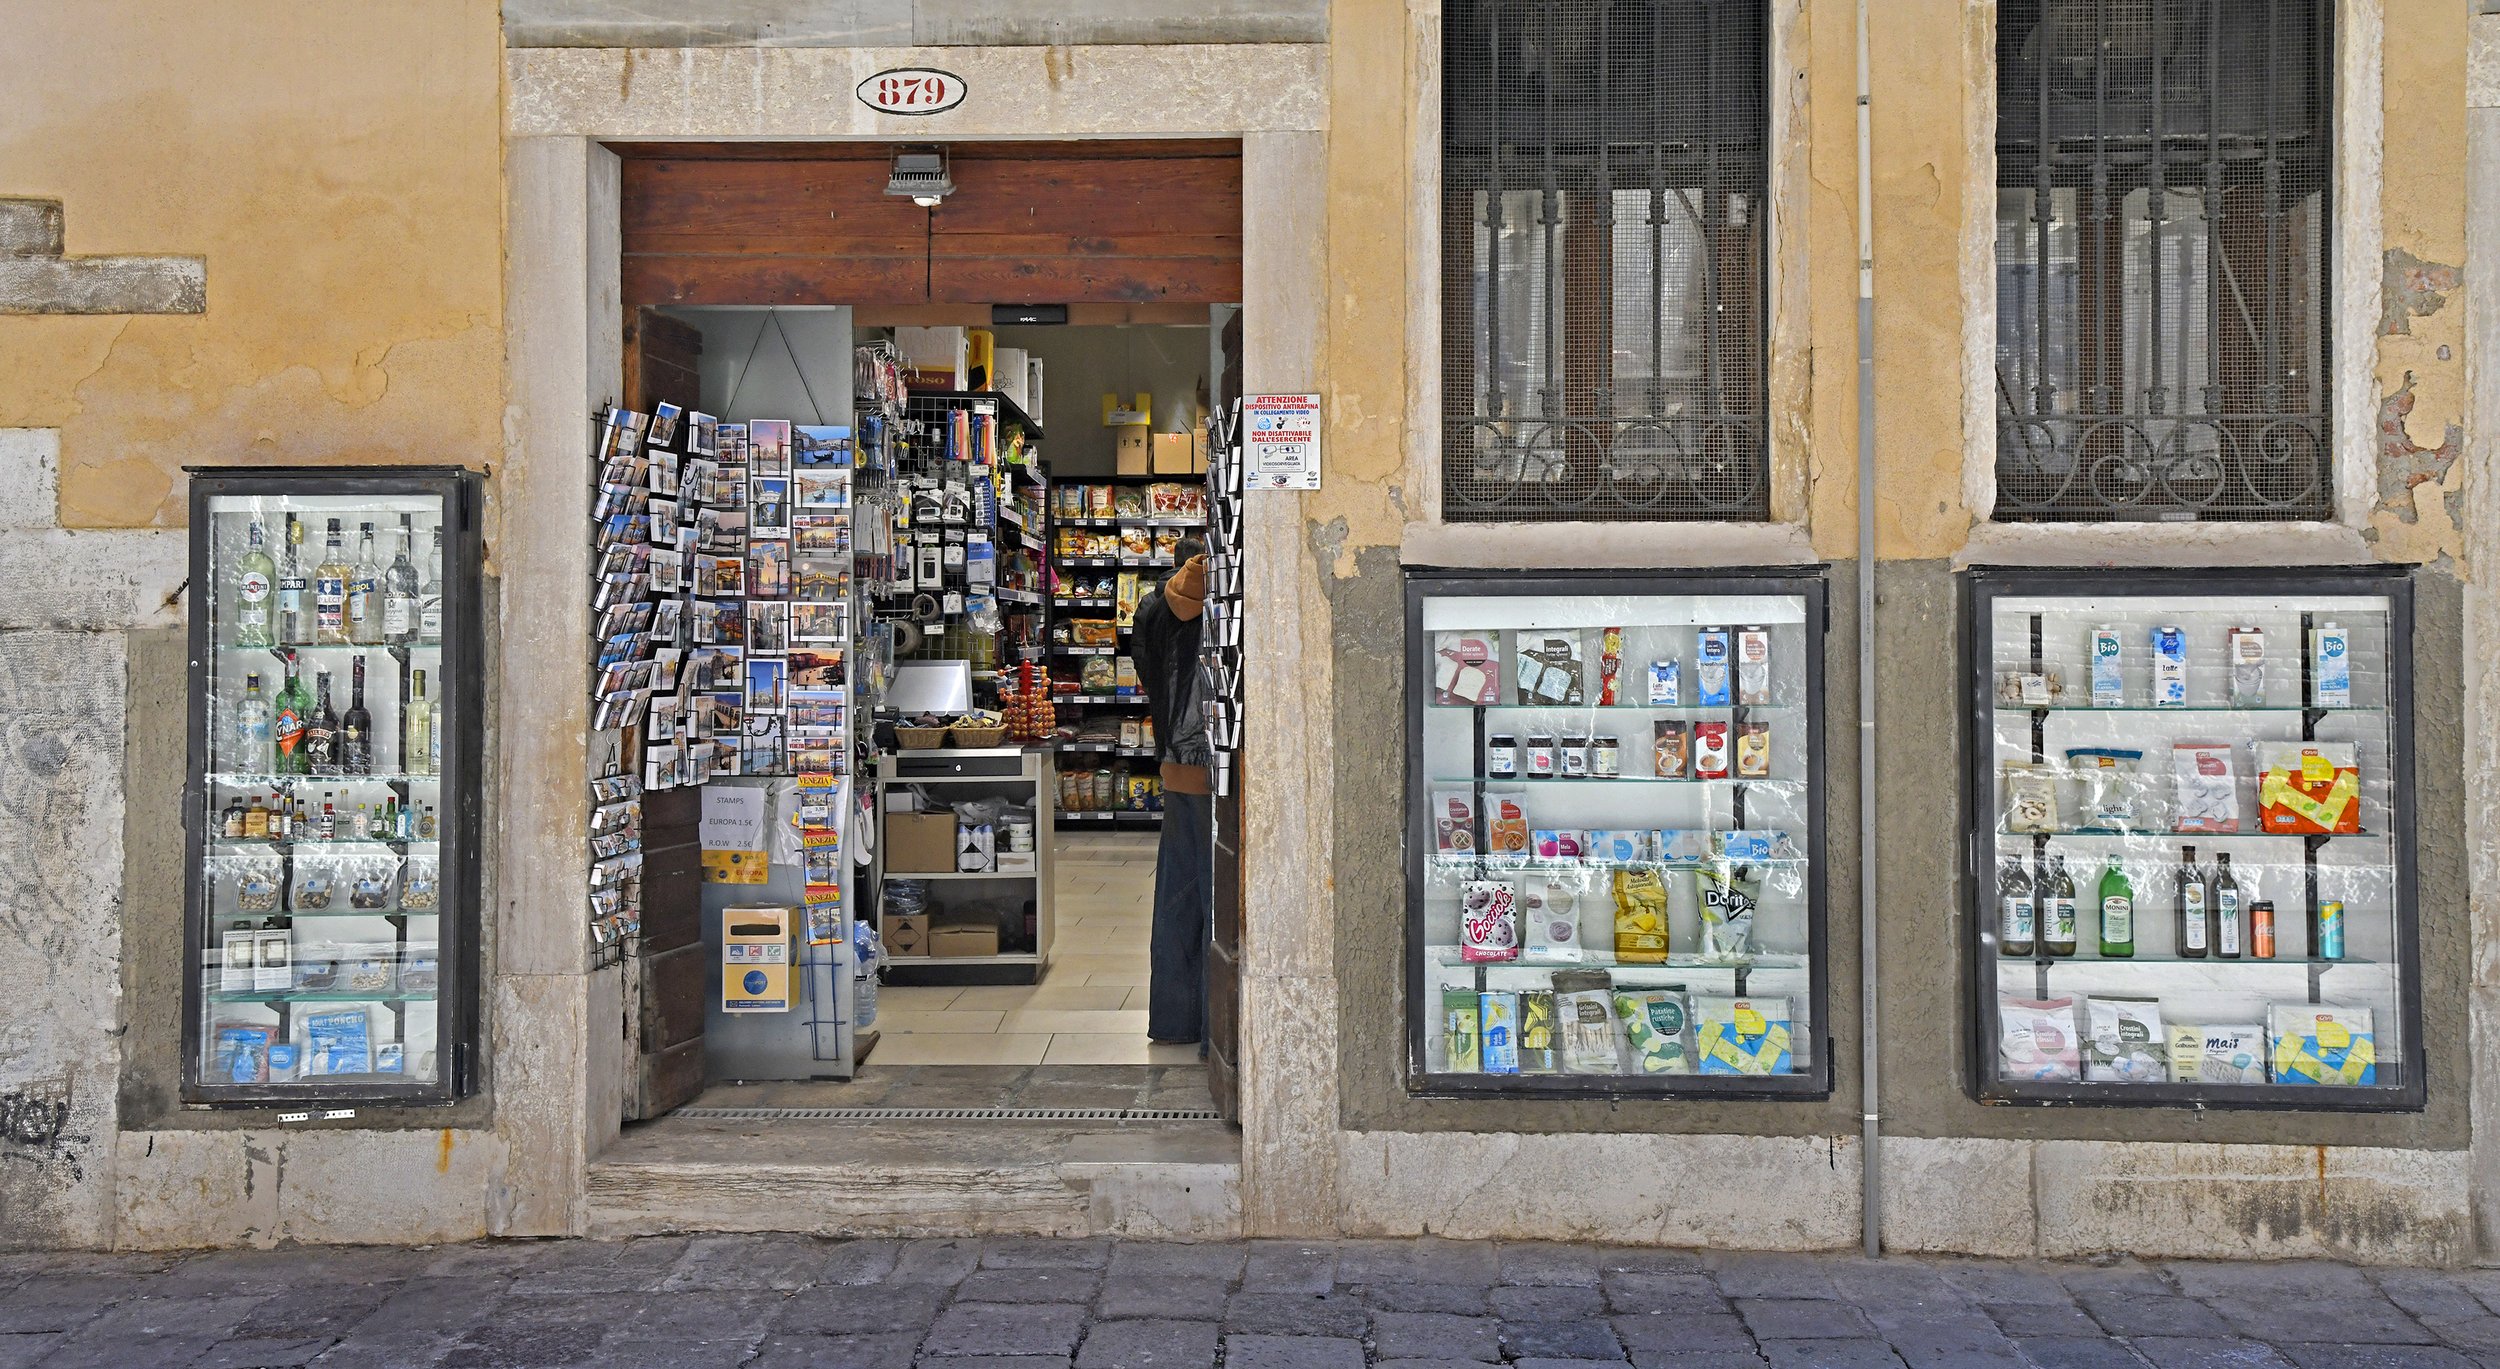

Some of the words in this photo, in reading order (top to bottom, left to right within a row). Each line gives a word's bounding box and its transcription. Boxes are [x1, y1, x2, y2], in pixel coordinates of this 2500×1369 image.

[878, 77, 945, 105] 879
[1546, 645, 1568, 654] Integrali
[2100, 642, 2117, 653] Bio
[2325, 641, 2343, 652] Bio
[276, 720, 304, 741] CYNAR
[799, 776, 829, 785] VENEZIA
[2103, 804, 2123, 814] light
[709, 839, 729, 847] R.O.W
[805, 837, 837, 846] VENEZIA
[1752, 844, 1768, 855] Bio
[806, 893, 837, 902] VENEZIA
[1470, 889, 1511, 943] Gocciole
[328, 1015, 363, 1026] PONCHO
[2121, 1030, 2144, 1038] integrali
